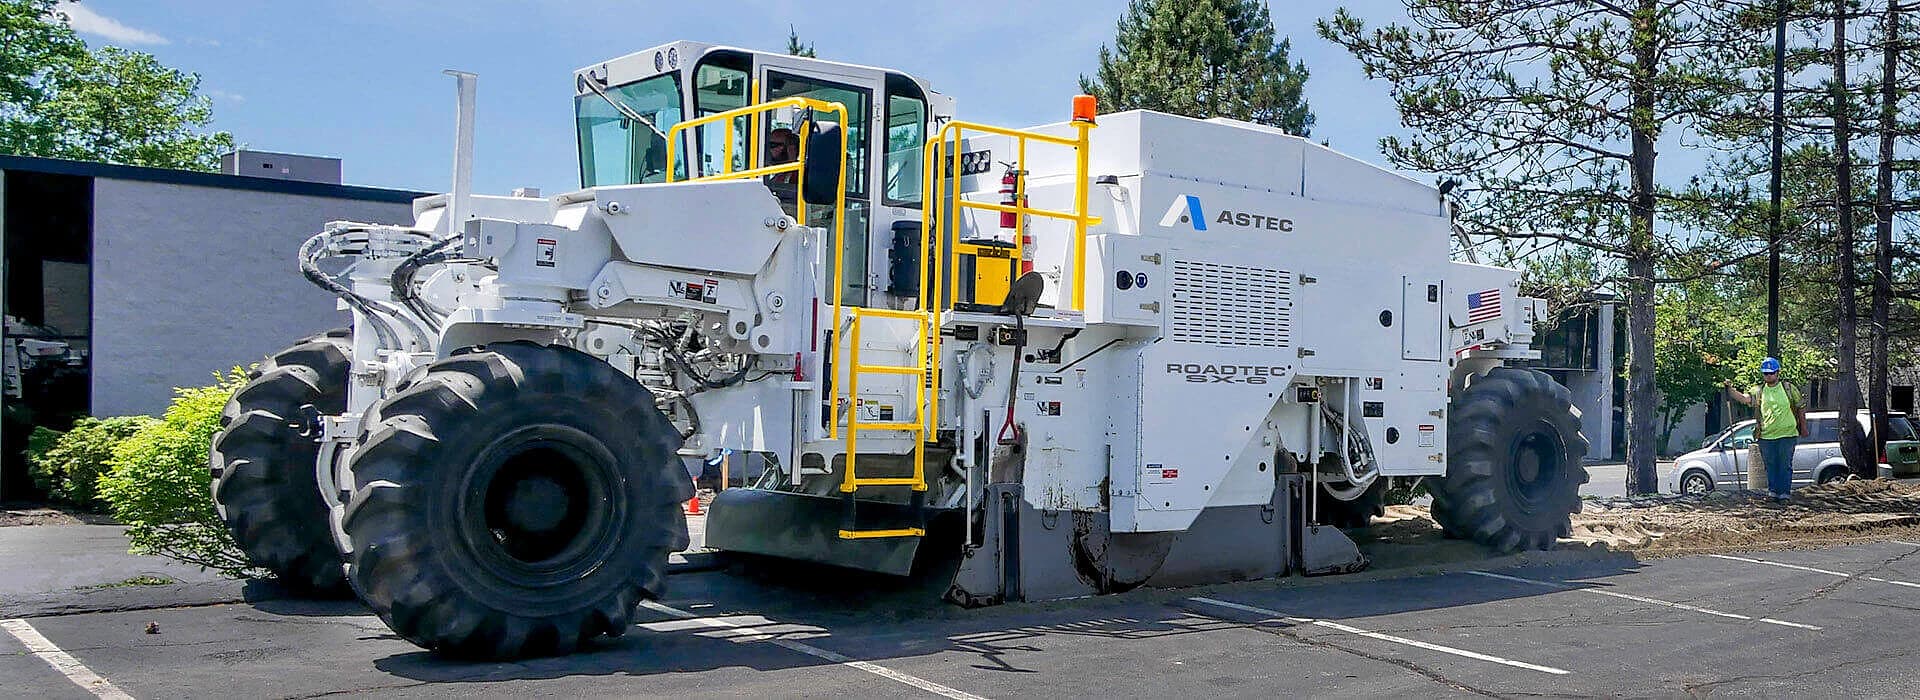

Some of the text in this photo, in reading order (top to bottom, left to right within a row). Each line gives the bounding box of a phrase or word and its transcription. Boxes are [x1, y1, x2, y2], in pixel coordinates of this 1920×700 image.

[1216, 210, 1293, 232] ASTEC
[1166, 363, 1286, 377] ROADTEC
[1185, 374, 1267, 385] SX-6
